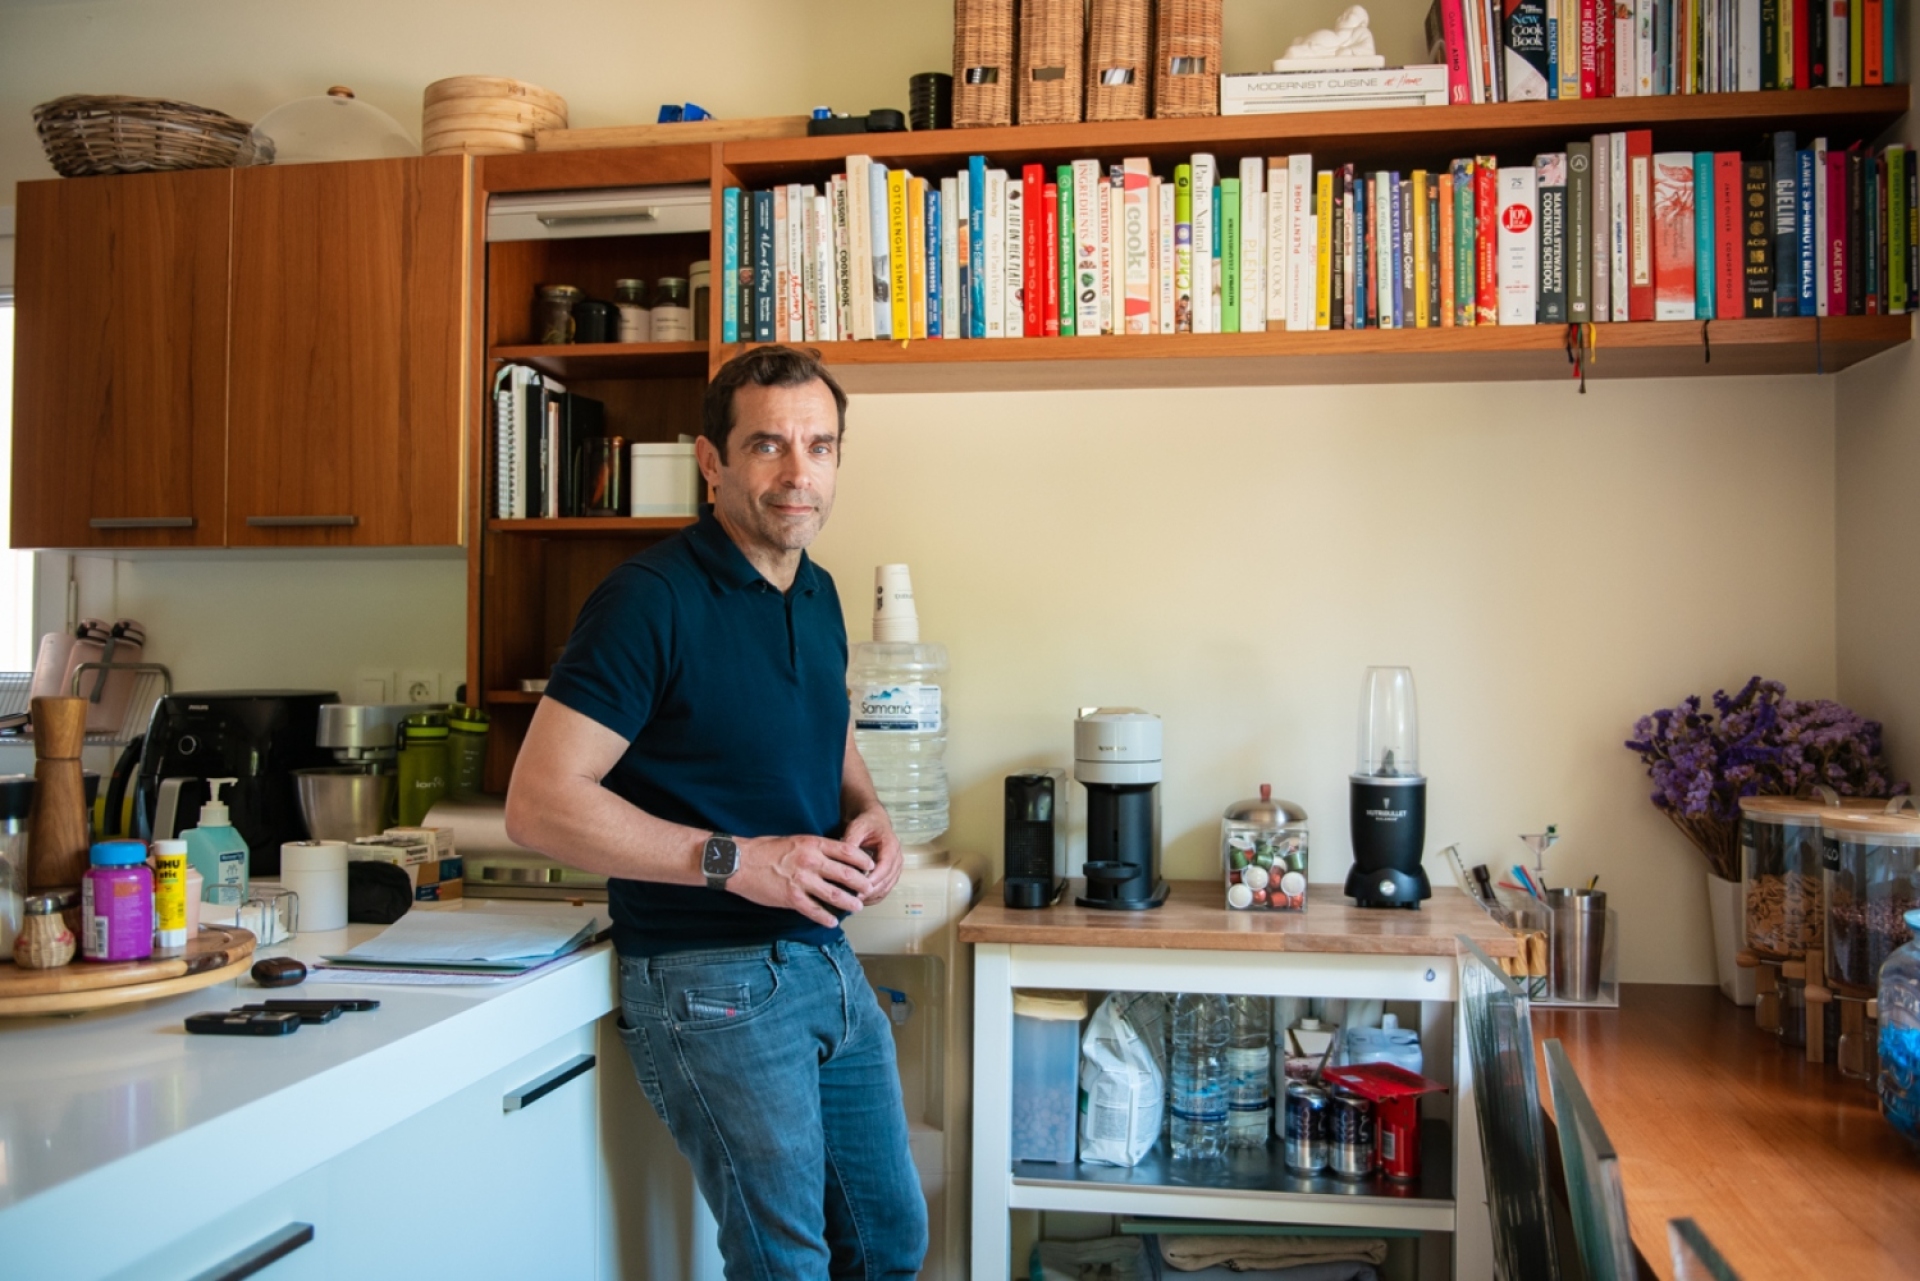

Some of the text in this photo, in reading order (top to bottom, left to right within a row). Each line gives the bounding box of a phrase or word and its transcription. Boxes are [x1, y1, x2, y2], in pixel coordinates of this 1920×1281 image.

[1512, 14, 1539, 24] New
[1512, 24, 1543, 36] Cook
[1582, 20, 1594, 44] GOOD
[1513, 34, 1543, 47] Book
[1582, 44, 1594, 72] STUFF
[1247, 80, 1324, 92] MODERNIST
[1328, 78, 1378, 88] CUISINE
[990, 178, 999, 217] donna hay
[1701, 163, 1709, 197] EVERYDAY
[927, 204, 935, 224] Happy
[1009, 213, 1020, 227] LOT
[1079, 164, 1088, 239] INGREDIENTS
[1100, 187, 1108, 243] NUTRITION
[1196, 164, 1208, 253] Pacific Natural
[1294, 184, 1302, 254] PLENTY MORE
[1776, 179, 1795, 235] GJELINA
[893, 184, 904, 304] OTTOLENGHI SIMPLE
[1009, 229, 1020, 240] ON
[1127, 206, 1146, 269] cook
[1272, 190, 1282, 298] THE WAY TO COOK
[1543, 192, 1552, 293] COOKING SCHOOL
[1802, 154, 1812, 298] JAMIE'S 30-MINUTE MEALS
[760, 242, 772, 258] Love
[837, 190, 849, 307] MISSONI COOKBOOK
[1009, 243, 1020, 259] HER
[1335, 208, 1343, 299] The hummingbird bakery cookbook
[1404, 232, 1413, 289] Slow Cooker
[1834, 239, 1842, 294] CAKE DAYS
[758, 268, 771, 293] Eating
[1009, 262, 1020, 287] PLATE
[1028, 220, 1036, 324] OTTOLENGHI
[1176, 248, 1191, 290] Chef
[1243, 240, 1257, 305] PLENTY
[1746, 266, 1768, 274] HEAT
[819, 284, 827, 324] COOKBOOK
[156, 860, 180, 868] UHU
